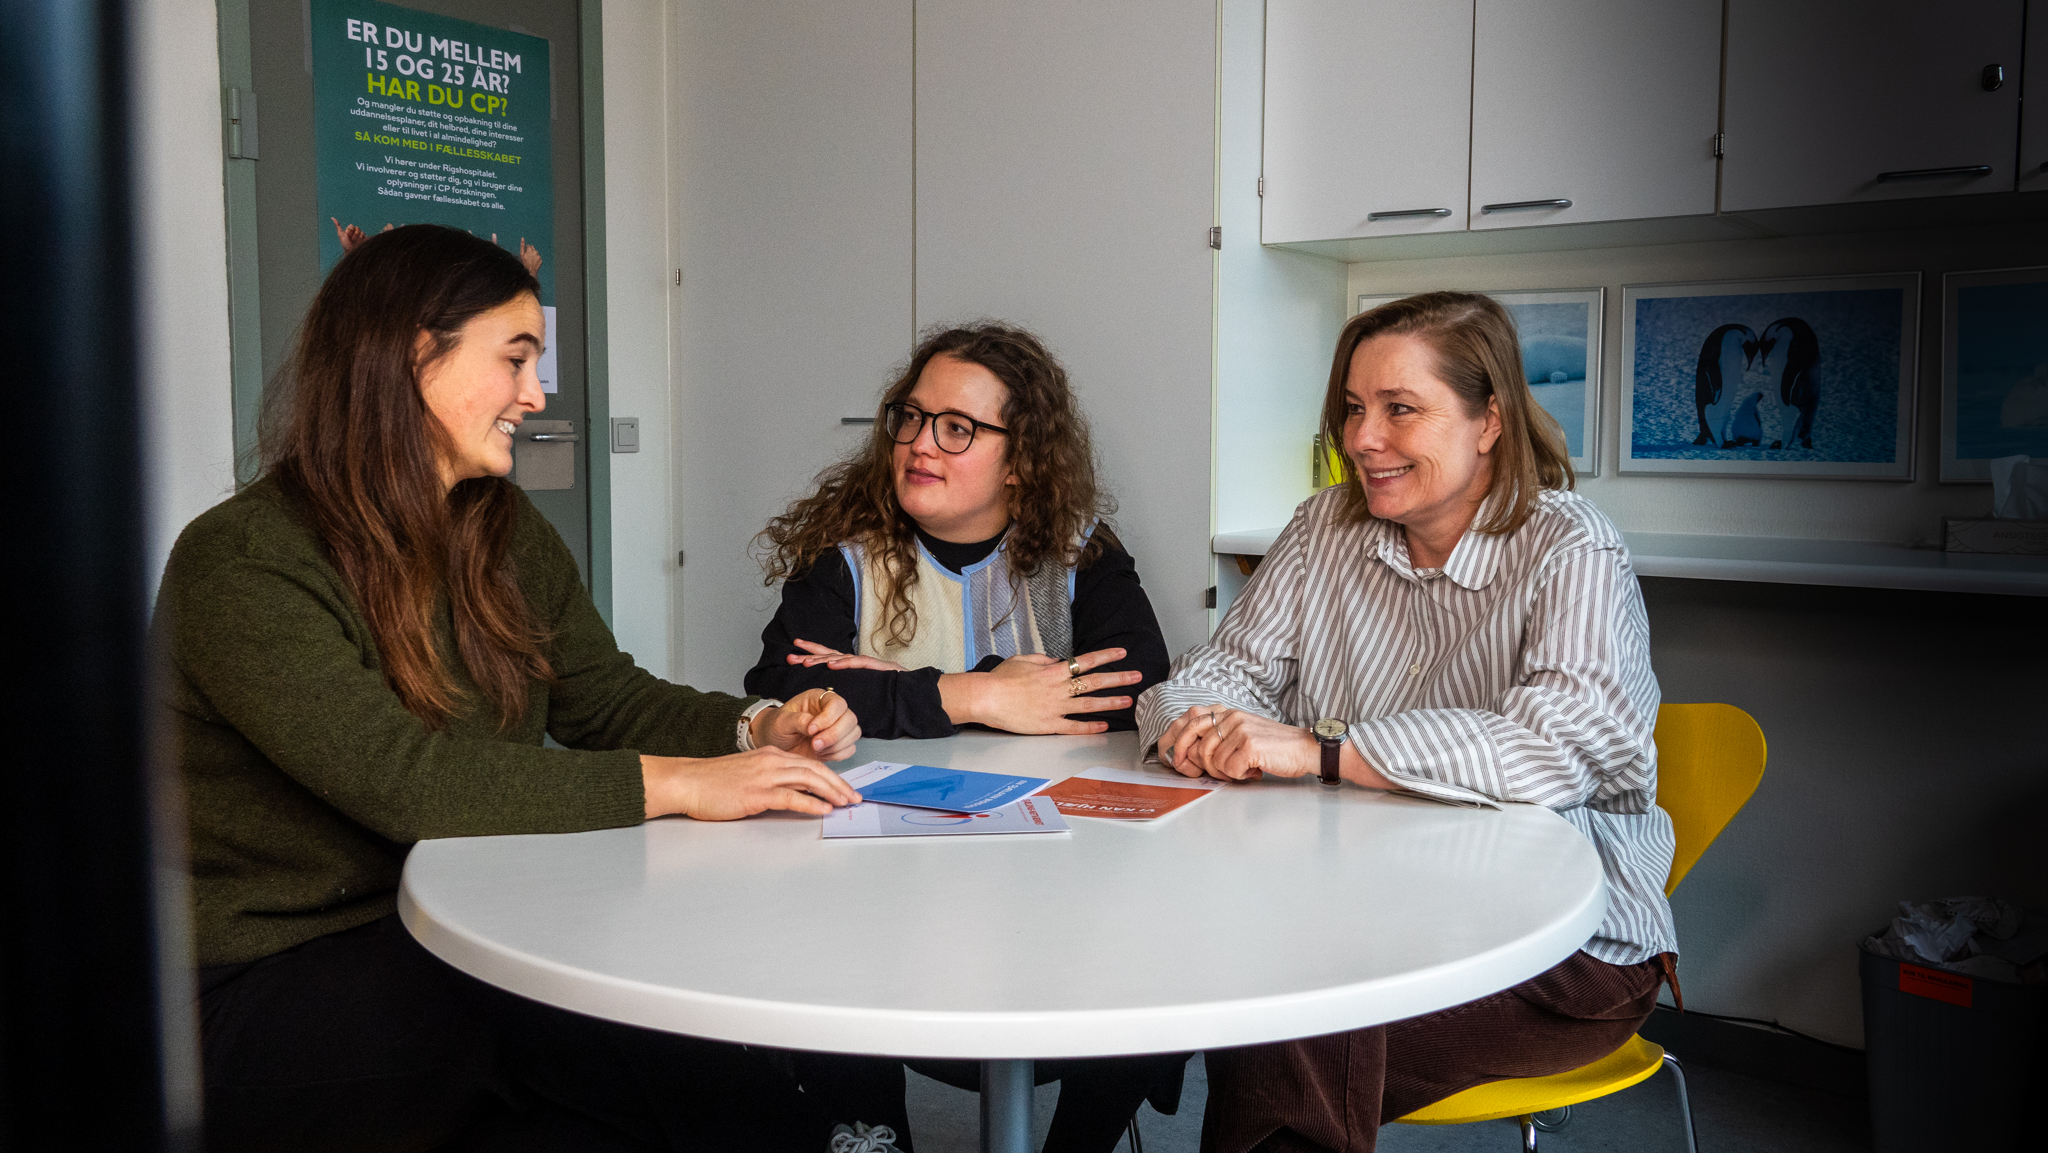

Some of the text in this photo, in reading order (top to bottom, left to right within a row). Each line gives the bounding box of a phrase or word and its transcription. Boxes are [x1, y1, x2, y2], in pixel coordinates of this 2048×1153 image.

[347, 19, 521, 74] ER DU MELLEM
[366, 48, 510, 94] 15 OG 25 ÅR?
[367, 73, 508, 116] HAR DU CP?
[350, 109, 524, 142] uddannelsesplaner, dit helbred, dine interesser
[357, 97, 369, 108] Og
[372, 102, 404, 112] mangler
[406, 106, 416, 114] du
[418, 109, 441, 118] støtte
[443, 114, 452, 122] og
[455, 116, 492, 128] opbakning
[502, 123, 517, 131] dine
[355, 131, 371, 142] SÅ
[374, 134, 399, 146] KOM
[403, 139, 427, 150] MED
[436, 144, 521, 164] FÆLLESSKABET
[383, 124, 400, 133] eller
[411, 128, 427, 137] livet
[442, 134, 496, 148] almindelighed?
[356, 162, 364, 170] Vi
[367, 164, 406, 176] involverer
[408, 172, 418, 180] og
[420, 173, 447, 181] støtter
[448, 176, 461, 185] dig,
[463, 179, 472, 187] og
[482, 180, 506, 190] bruger
[508, 184, 522, 192] dine
[385, 155, 497, 178] Vi hører under Rigshospitalet.
[378, 187, 403, 197] Sådan
[405, 192, 431, 200] gavner
[433, 194, 480, 207] fællesskabet
[387, 179, 432, 191] oplysninger
[452, 186, 496, 199] forskningen.
